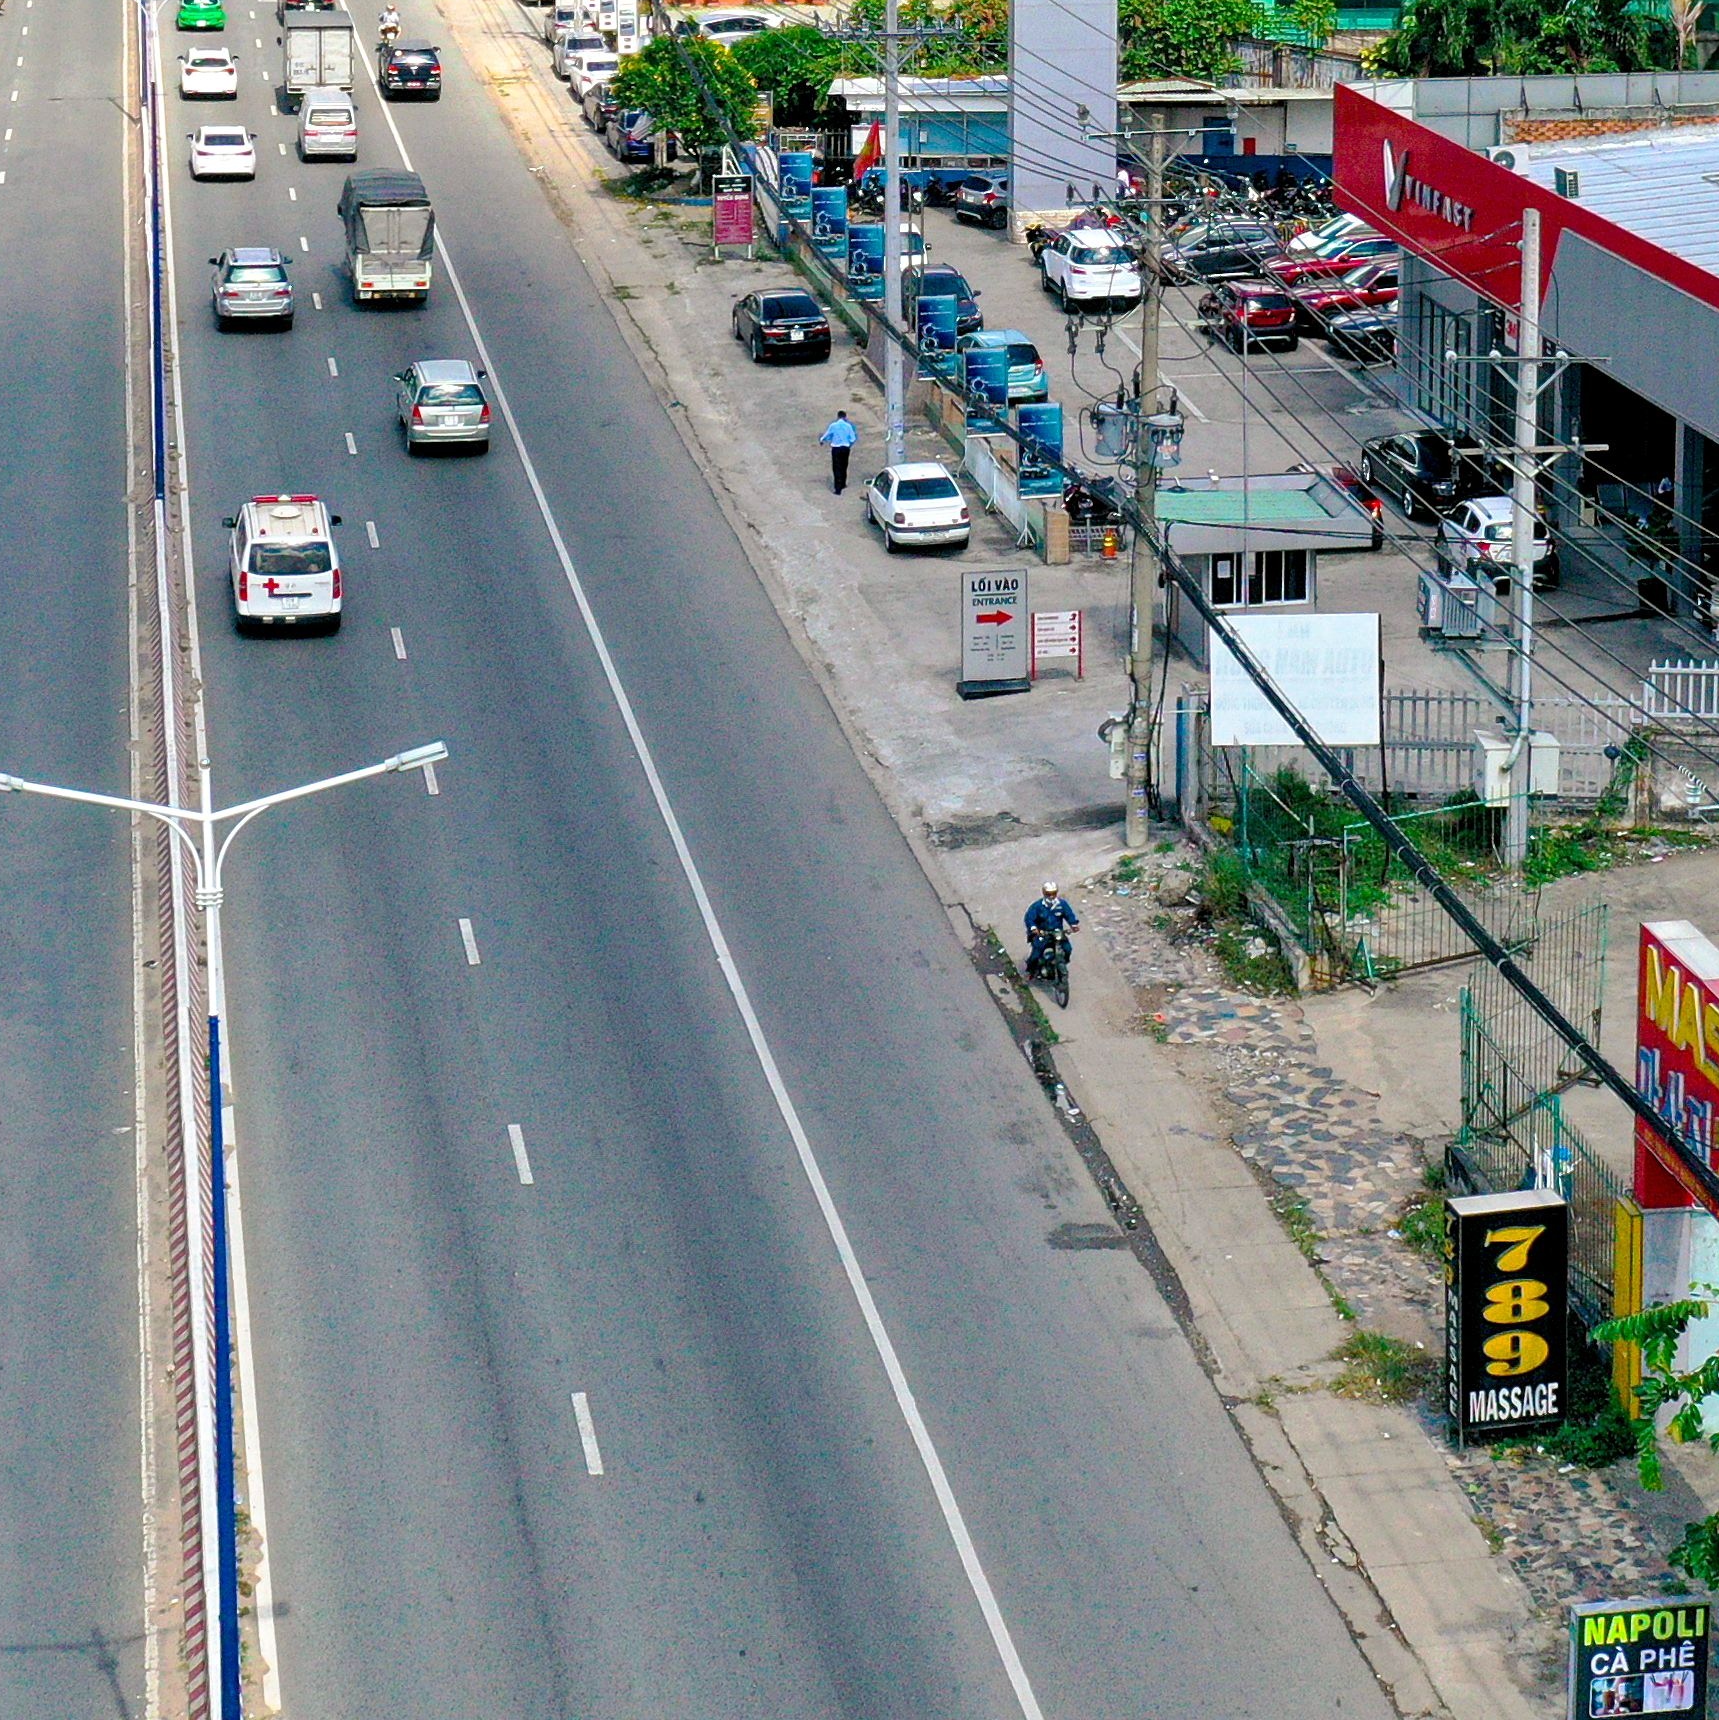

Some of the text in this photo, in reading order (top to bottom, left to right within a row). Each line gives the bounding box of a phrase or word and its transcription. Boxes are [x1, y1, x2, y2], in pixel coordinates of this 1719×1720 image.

[1405, 174, 1473, 233] VINFAST
[971, 577, 1019, 593] LỐI VÀO
[972, 596, 1017, 606] ENTRANCE
[1482, 1224, 1550, 1377] 789
[1469, 1381, 1560, 1424] MASSAGE
[1584, 1608, 1705, 1646] NAPOLI
[1590, 1640, 1696, 1675] CÀ PHÊ
